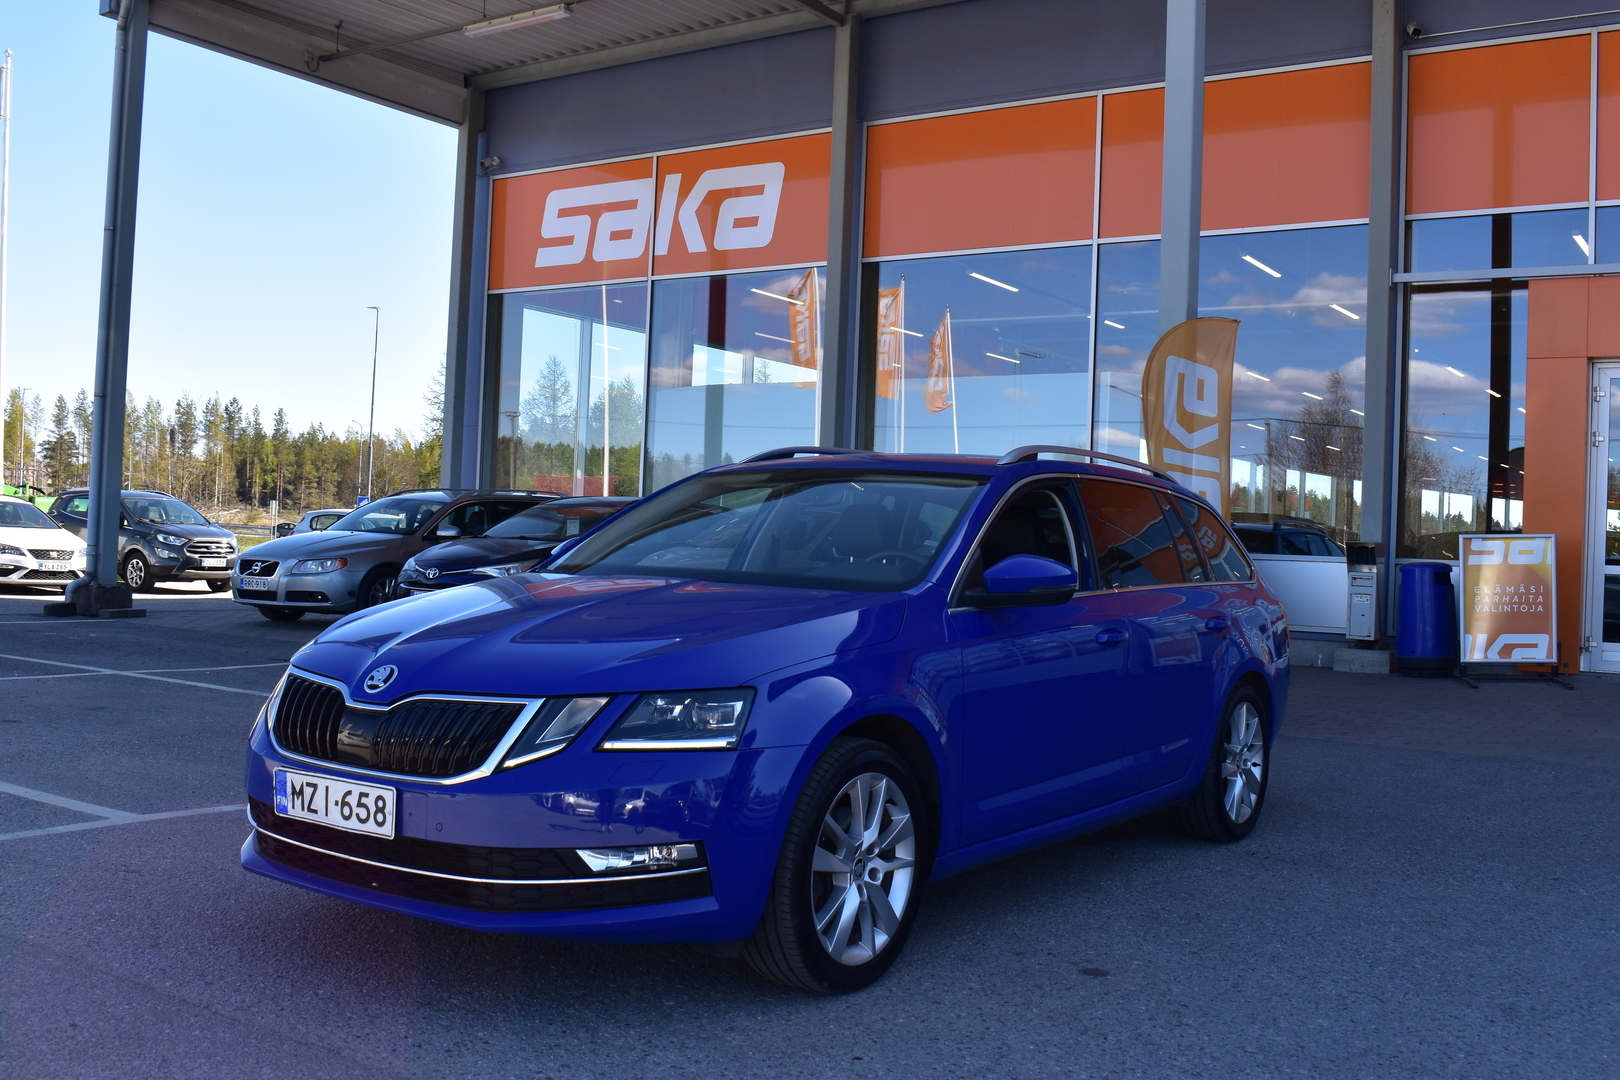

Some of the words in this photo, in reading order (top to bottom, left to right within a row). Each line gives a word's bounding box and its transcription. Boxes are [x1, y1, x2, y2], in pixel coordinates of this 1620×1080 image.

[1474, 584, 1543, 593] ELÄMÄSI
[1474, 595, 1544, 603] PARHAITA
[277, 795, 288, 807] FIN
[290, 778, 387, 828] MZI-658
